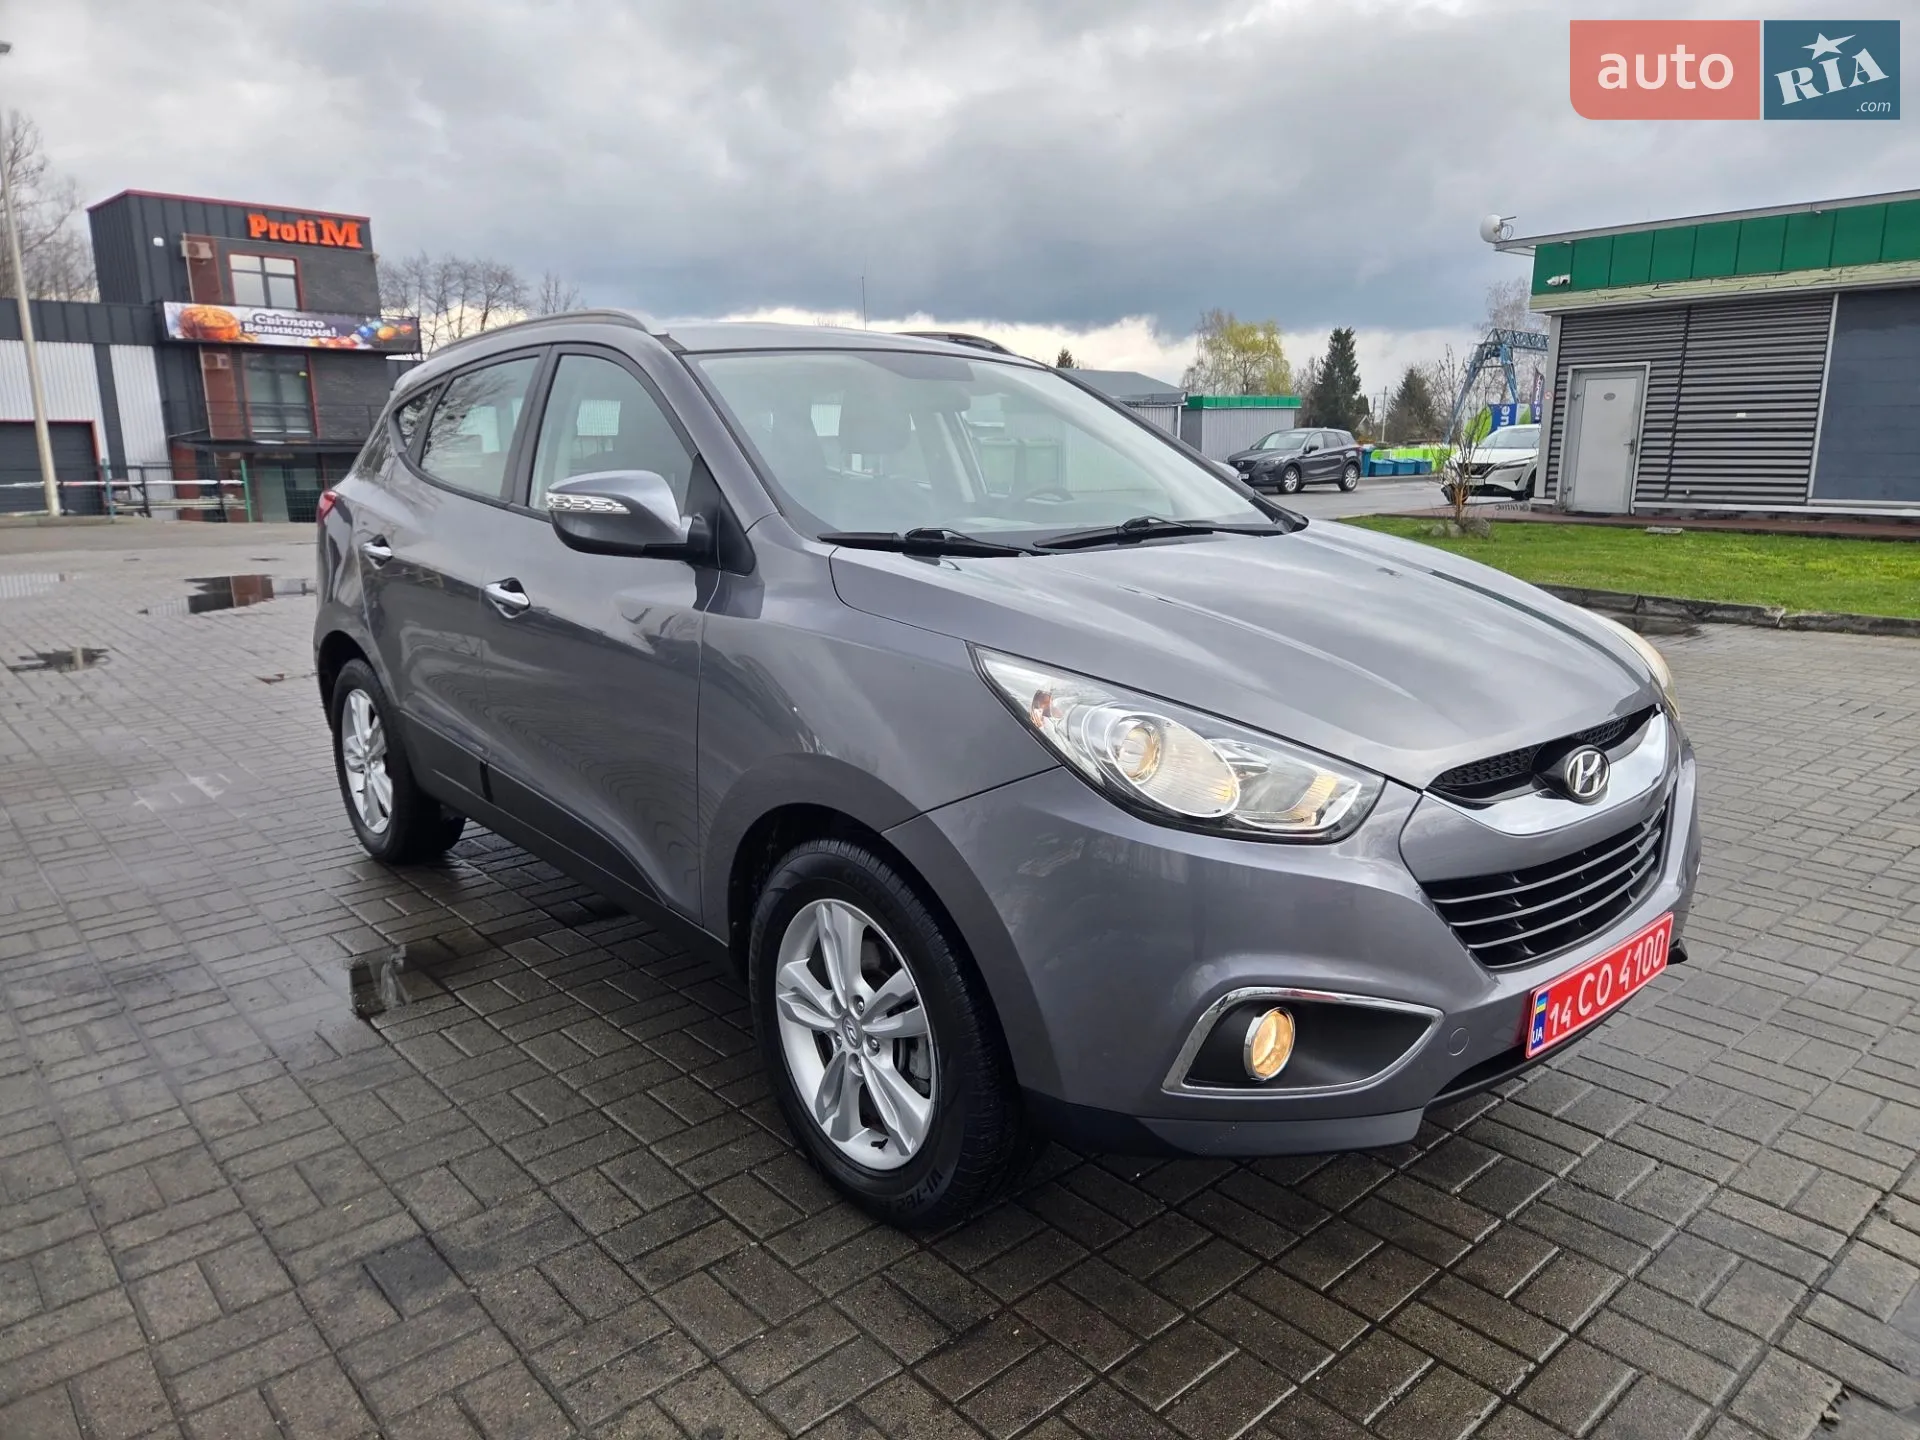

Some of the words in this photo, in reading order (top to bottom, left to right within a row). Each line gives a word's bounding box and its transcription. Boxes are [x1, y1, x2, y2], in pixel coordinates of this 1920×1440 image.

[244, 322, 337, 337] Великодня!
[254, 314, 326, 328] Світлого
[1501, 405, 1511, 426] ue
[1549, 995, 1572, 1036] 14
[1577, 963, 1613, 1017] CO
[1619, 928, 1666, 991] 4100
[1531, 1026, 1543, 1044] UA
